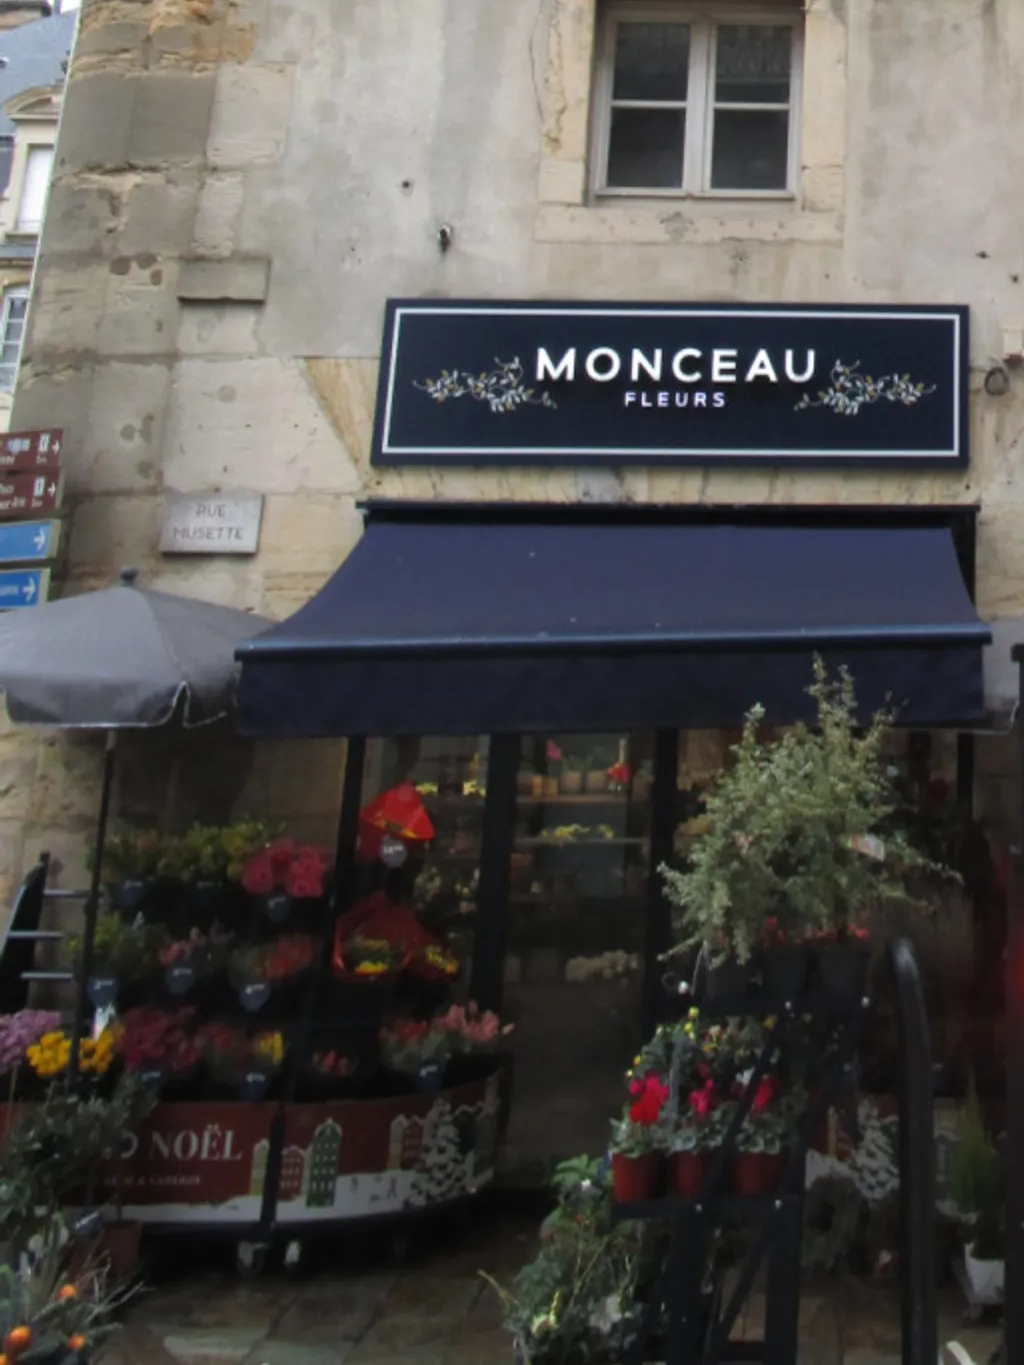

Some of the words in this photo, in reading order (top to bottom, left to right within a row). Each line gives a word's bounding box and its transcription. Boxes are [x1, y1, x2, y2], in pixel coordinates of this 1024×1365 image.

[535, 346, 816, 384] MONCEAU
[623, 391, 727, 409] FLEURS
[195, 503, 227, 518] RUE
[172, 527, 243, 540] MUSETTE
[149, 1122, 244, 1161] NOËL
